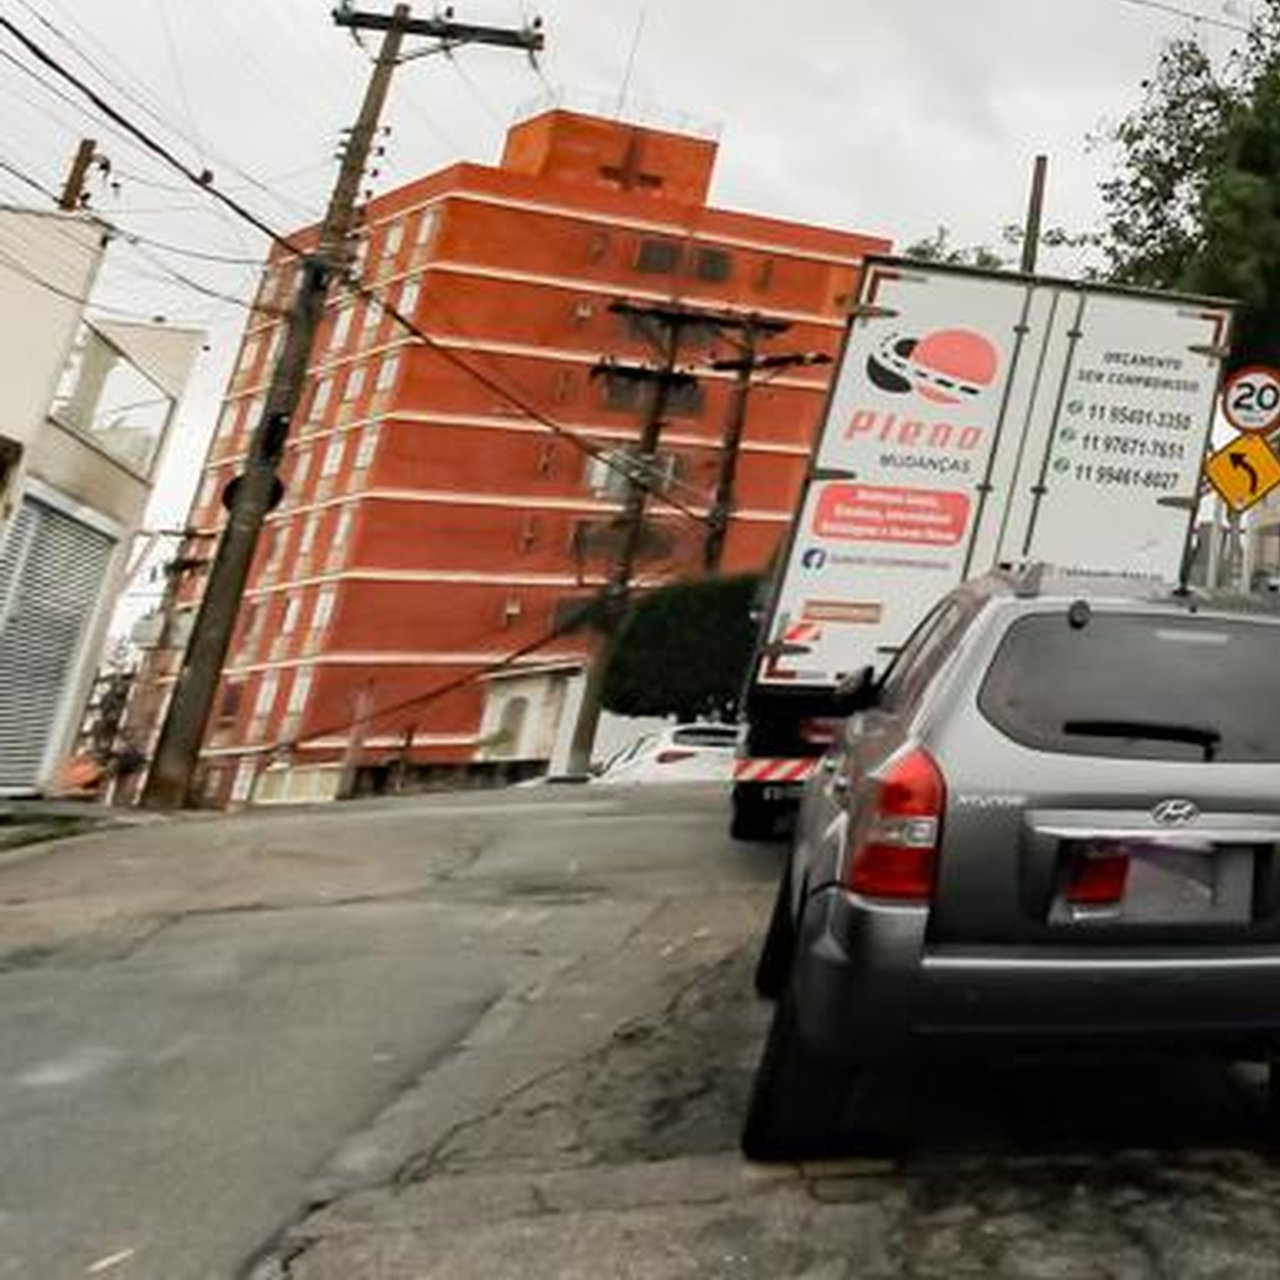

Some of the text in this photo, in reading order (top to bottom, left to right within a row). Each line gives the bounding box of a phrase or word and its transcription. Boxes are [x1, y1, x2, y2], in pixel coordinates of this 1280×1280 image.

[1233, 382, 1280, 410] 20
[1088, 404, 1106, 420] 11
[1082, 433, 1099, 451] 11
[879, 453, 971, 474] MUDANÇAS
[1075, 463, 1092, 480] 11
